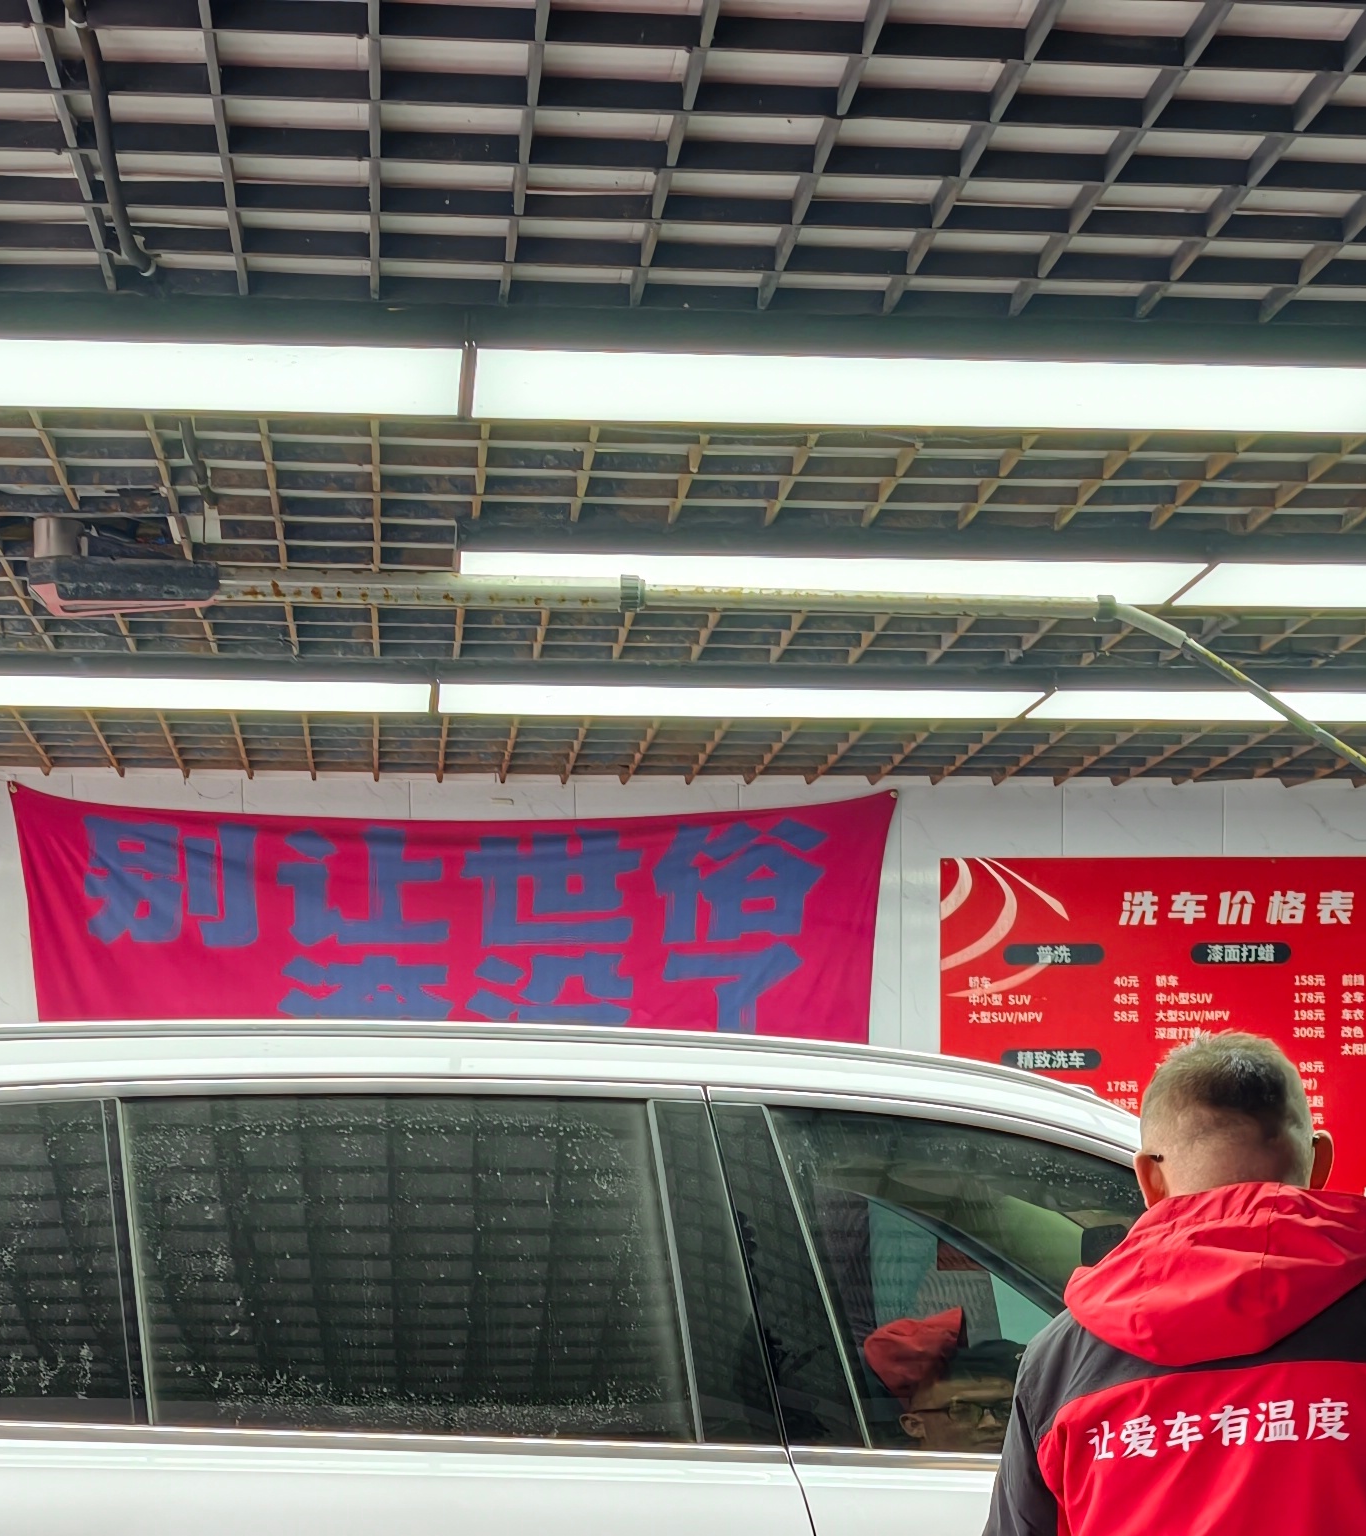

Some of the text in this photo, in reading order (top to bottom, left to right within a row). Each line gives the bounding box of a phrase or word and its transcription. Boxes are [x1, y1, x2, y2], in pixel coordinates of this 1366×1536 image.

[82, 815, 830, 948] 别让世俗
[1119, 890, 1355, 925] 洗车价格表
[1036, 944, 1072, 964] 普洗
[1207, 944, 1275, 963] 漆面打蜡
[1113, 975, 1140, 988] 40元
[1293, 974, 1326, 987] 158元
[1008, 994, 1032, 1006] SUV
[1113, 993, 1140, 1006] 48元
[1293, 992, 1326, 1005] 178元
[1341, 991, 1365, 1004] 全车
[968, 1010, 1140, 1025] 大型SUV/MPV 58元
[1155, 1009, 1326, 1023] 大型SUV/MPV 198元
[1341, 1008, 1365, 1021] 车衣
[1292, 1026, 1326, 1039] 300元
[1016, 1050, 1086, 1069] 精致洗车
[1106, 1080, 1139, 1093] 178元
[1085, 1397, 1351, 1462] 让爱车有温度
